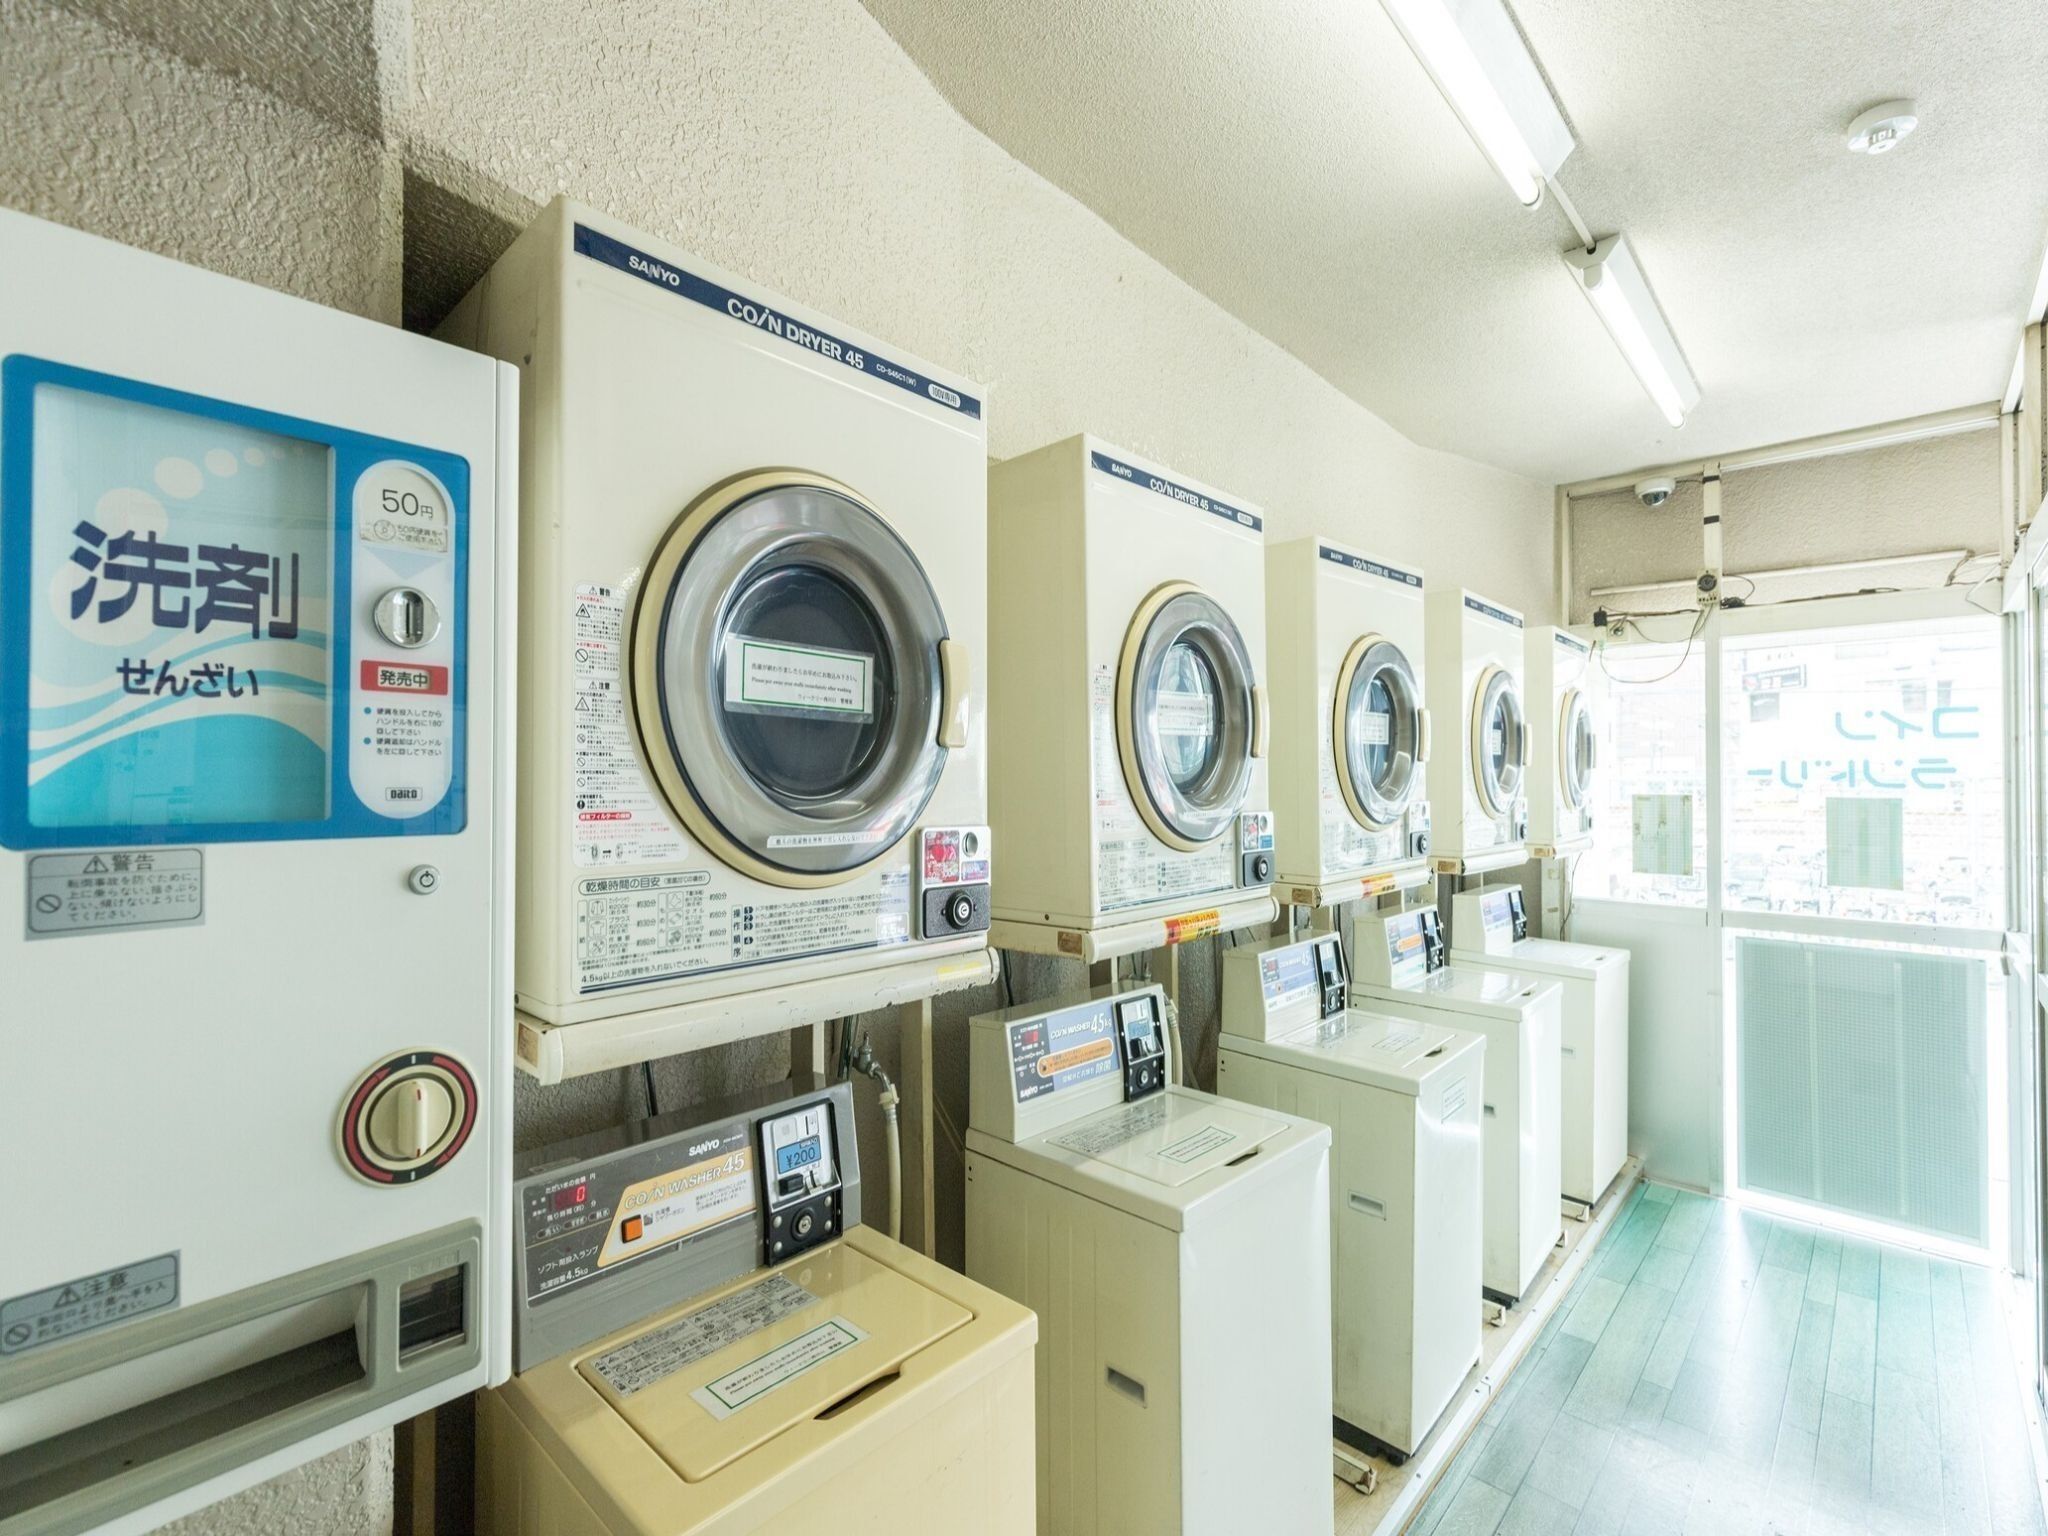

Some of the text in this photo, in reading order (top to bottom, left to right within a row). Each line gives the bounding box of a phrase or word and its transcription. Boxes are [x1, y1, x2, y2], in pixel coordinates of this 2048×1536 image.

[629, 255, 680, 286] SANYO
[786, 321, 842, 362] DRYER
[845, 349, 865, 369] 45
[1111, 463, 1132, 478] SANYO
[382, 488, 434, 520] 50円
[1174, 488, 1199, 508] DRYER
[1199, 496, 1209, 511] 45
[69, 519, 299, 640] 洗剤
[116, 657, 259, 698] せんざい
[380, 669, 428, 688] 発売中
[112, 853, 155, 871] 警告
[585, 877, 661, 893] 乾燥時間の目安
[688, 1139, 720, 1157] SANYO
[786, 1147, 816, 1168] ¥200
[589, 1172, 596, 1180] 円
[668, 1167, 721, 1194] WASHER
[722, 1152, 745, 1174] 45
[576, 1186, 586, 1202] 0
[83, 1271, 129, 1298] 注意
